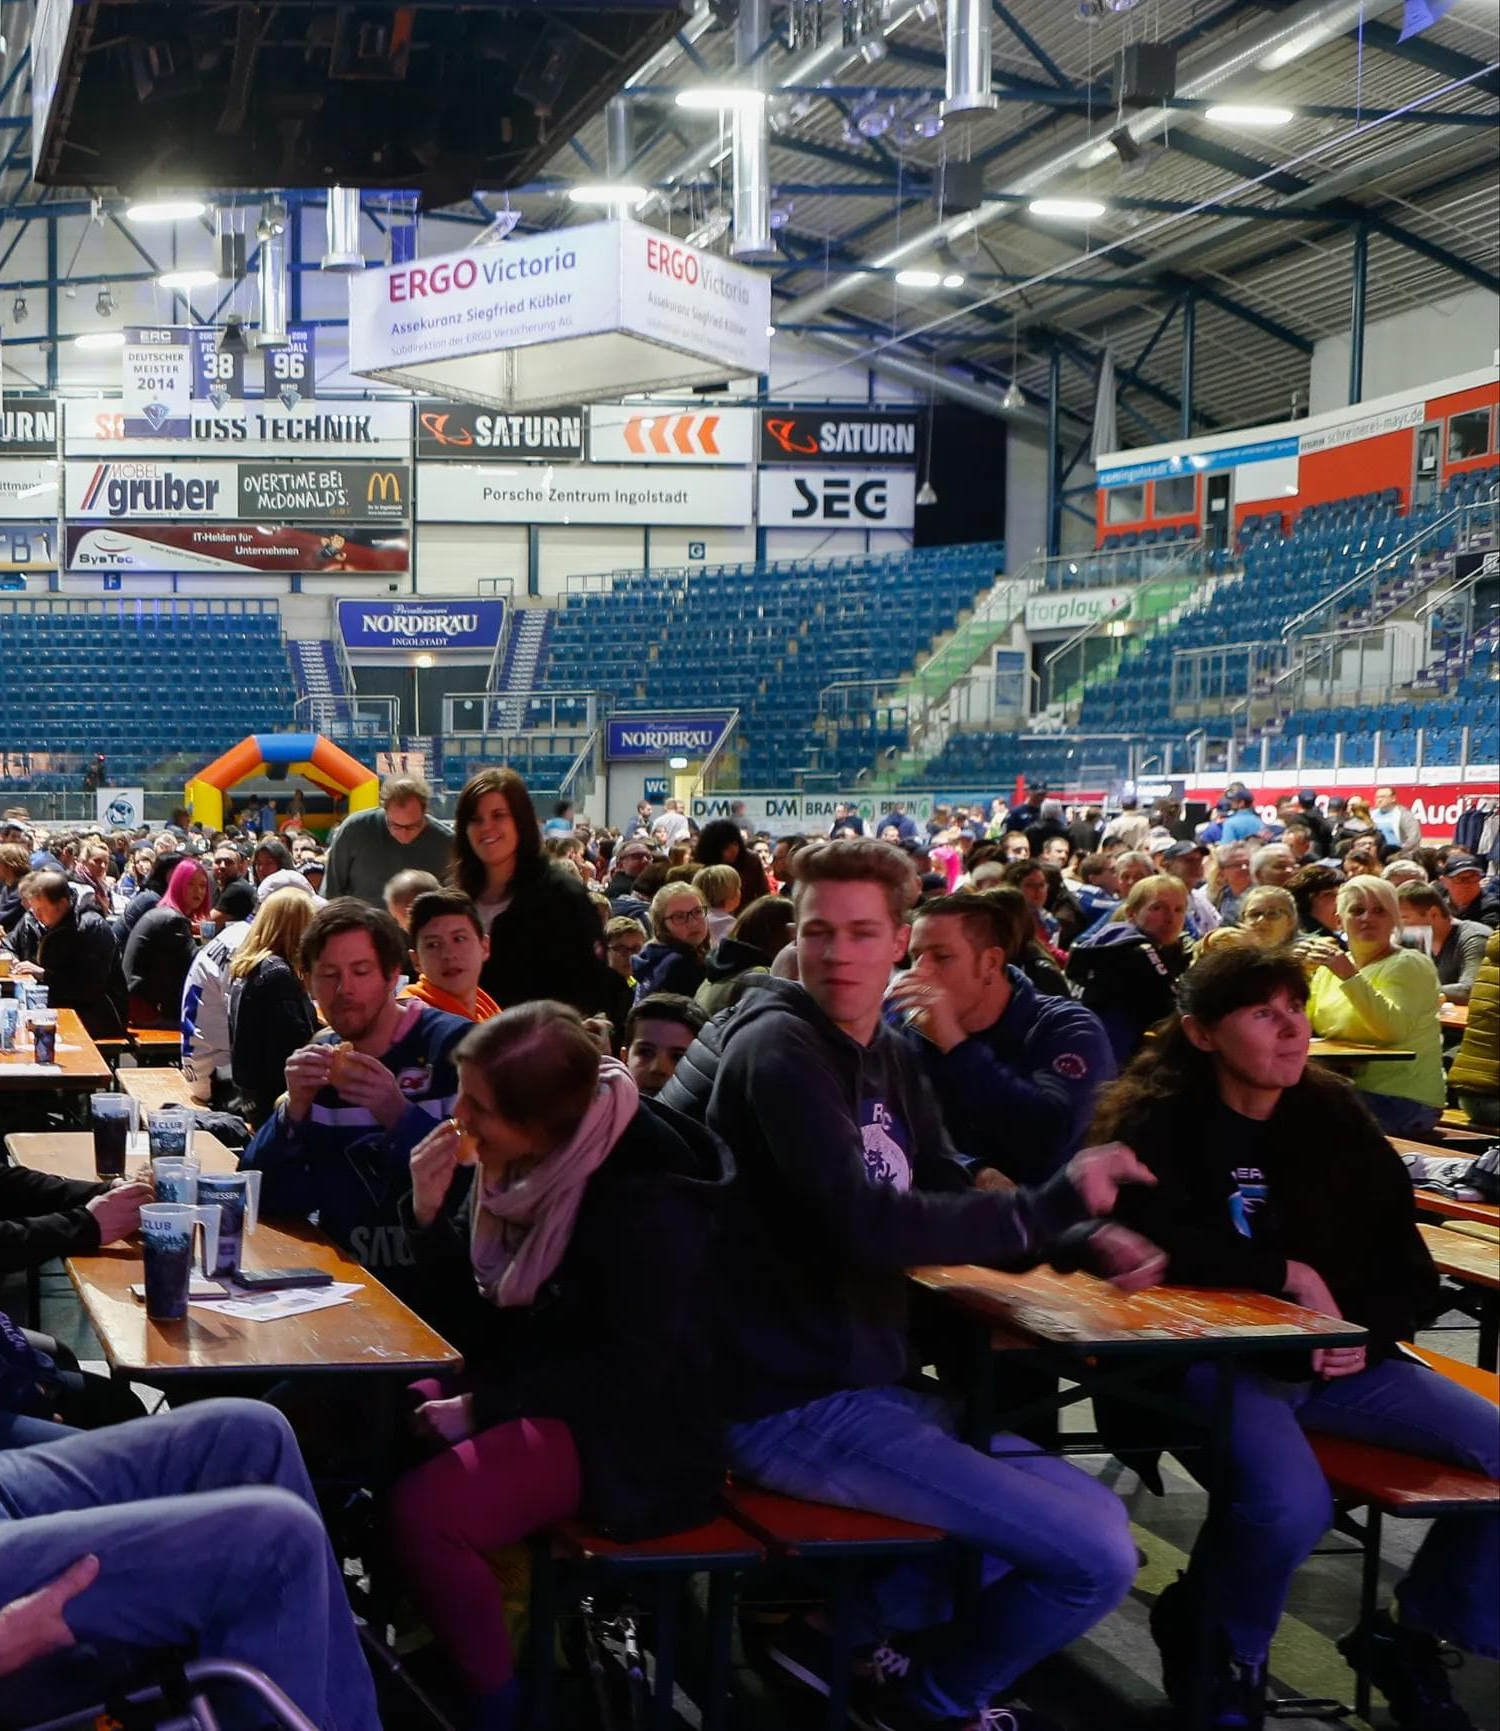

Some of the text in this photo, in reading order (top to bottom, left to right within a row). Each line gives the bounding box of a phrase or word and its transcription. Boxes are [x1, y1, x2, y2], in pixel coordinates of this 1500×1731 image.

[389, 246, 577, 302] ERGO Victoria
[647, 238, 750, 305] ERGO Victoria
[391, 292, 573, 335] Assekuranz Siegfried Kübler
[140, 331, 172, 343] ERC
[391, 338, 446, 356] Subdirektion
[449, 335, 464, 347] der
[466, 332, 492, 344] ERGO
[493, 321, 556, 339] Versicherung
[128, 352, 184, 362] DEUTSCHER
[203, 353, 234, 379] 38
[274, 353, 305, 379] 96
[133, 364, 179, 374] MEISTER
[137, 378, 175, 390] 2014
[1, 411, 55, 442] URN
[475, 415, 581, 447] SATURN
[820, 421, 915, 453] SATURN
[109, 464, 161, 479] MÖBEL
[108, 472, 220, 516] gruber
[482, 487, 689, 506] Porsche Zentrum Ingolstadt
[791, 478, 888, 520] SEG
[193, 532, 253, 542] IT-Helden für
[79, 552, 134, 566] SysTec
[235, 545, 300, 556] Unternehmen
[691, 544, 703, 558] G
[108, 575, 119, 588] F
[361, 614, 479, 636] NORDBRÄU
[391, 637, 450, 647] INGOLSTADT
[621, 729, 713, 749] NORDBRÄU
[645, 779, 670, 794] WC
